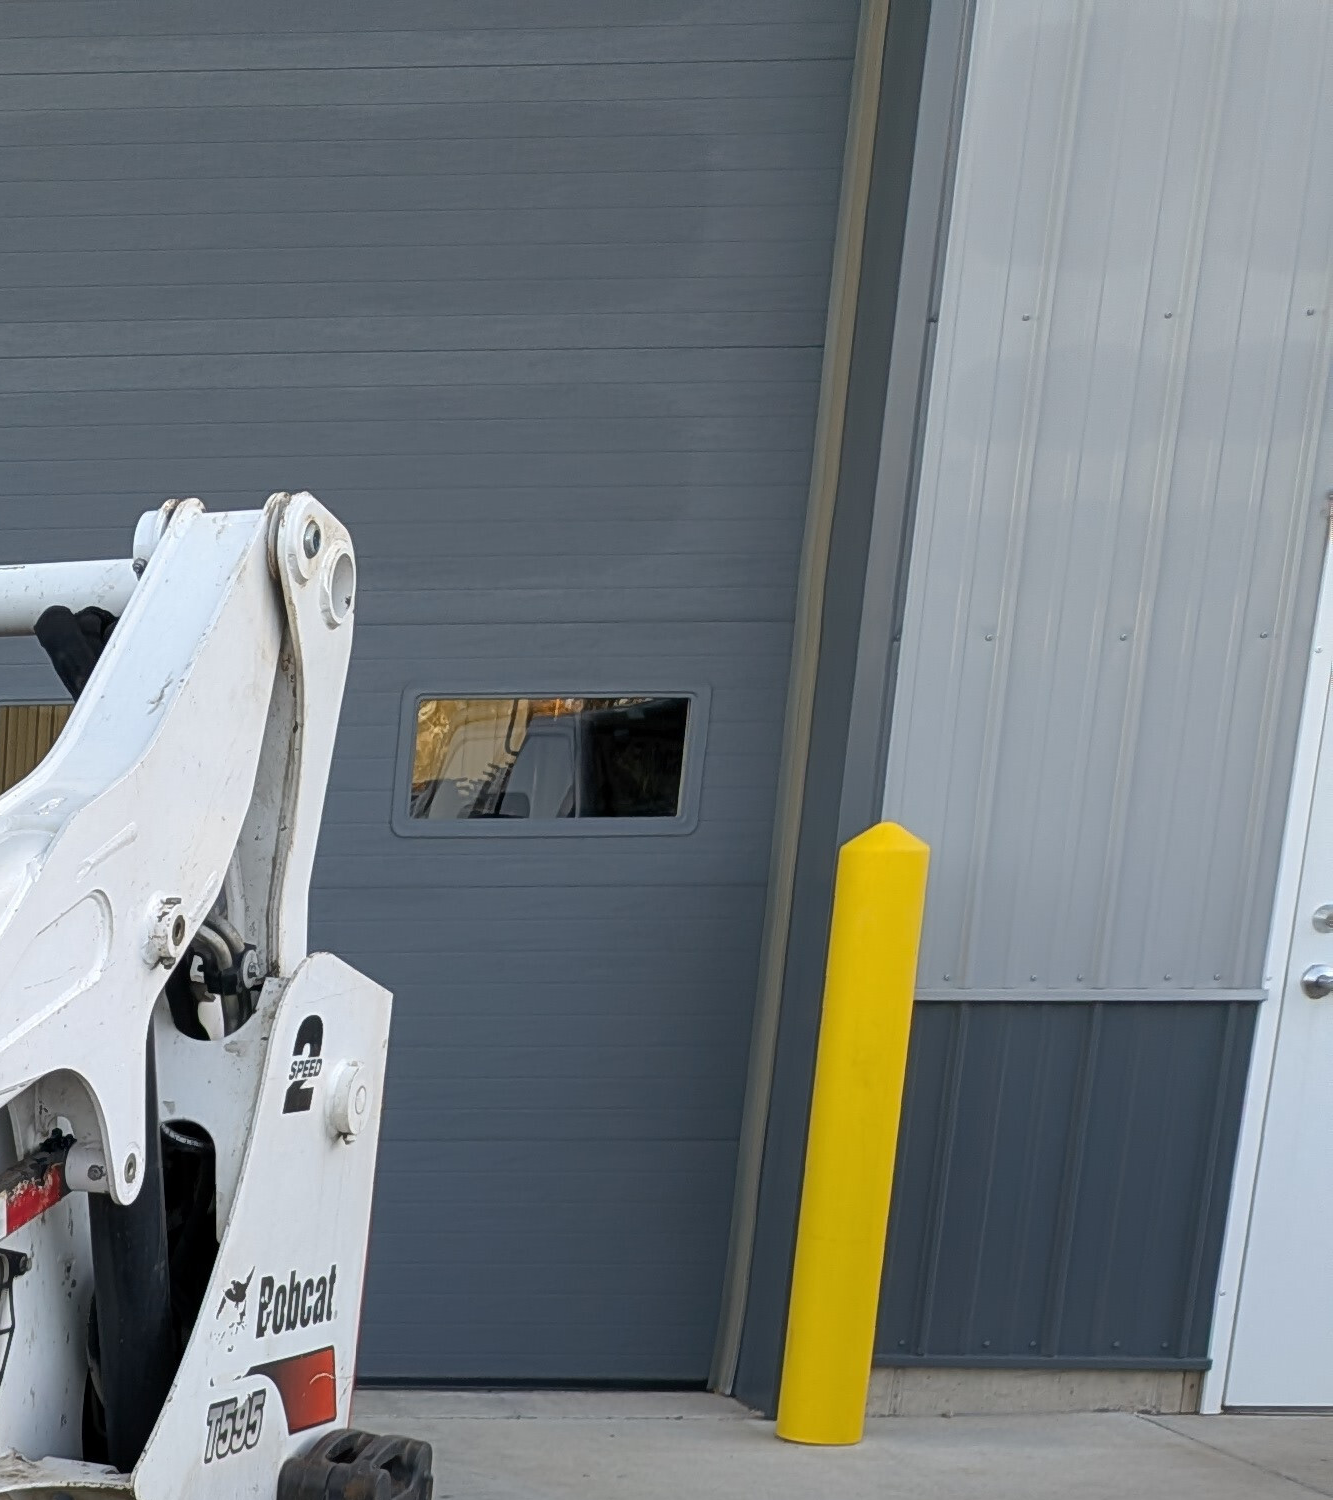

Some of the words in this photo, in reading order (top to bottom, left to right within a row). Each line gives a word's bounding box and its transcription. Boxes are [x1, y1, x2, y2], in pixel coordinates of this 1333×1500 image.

[282, 1014, 324, 1115] 2
[288, 1059, 323, 1080] SPEED
[255, 1264, 337, 1339] Bobcat
[204, 1388, 266, 1464] T595
